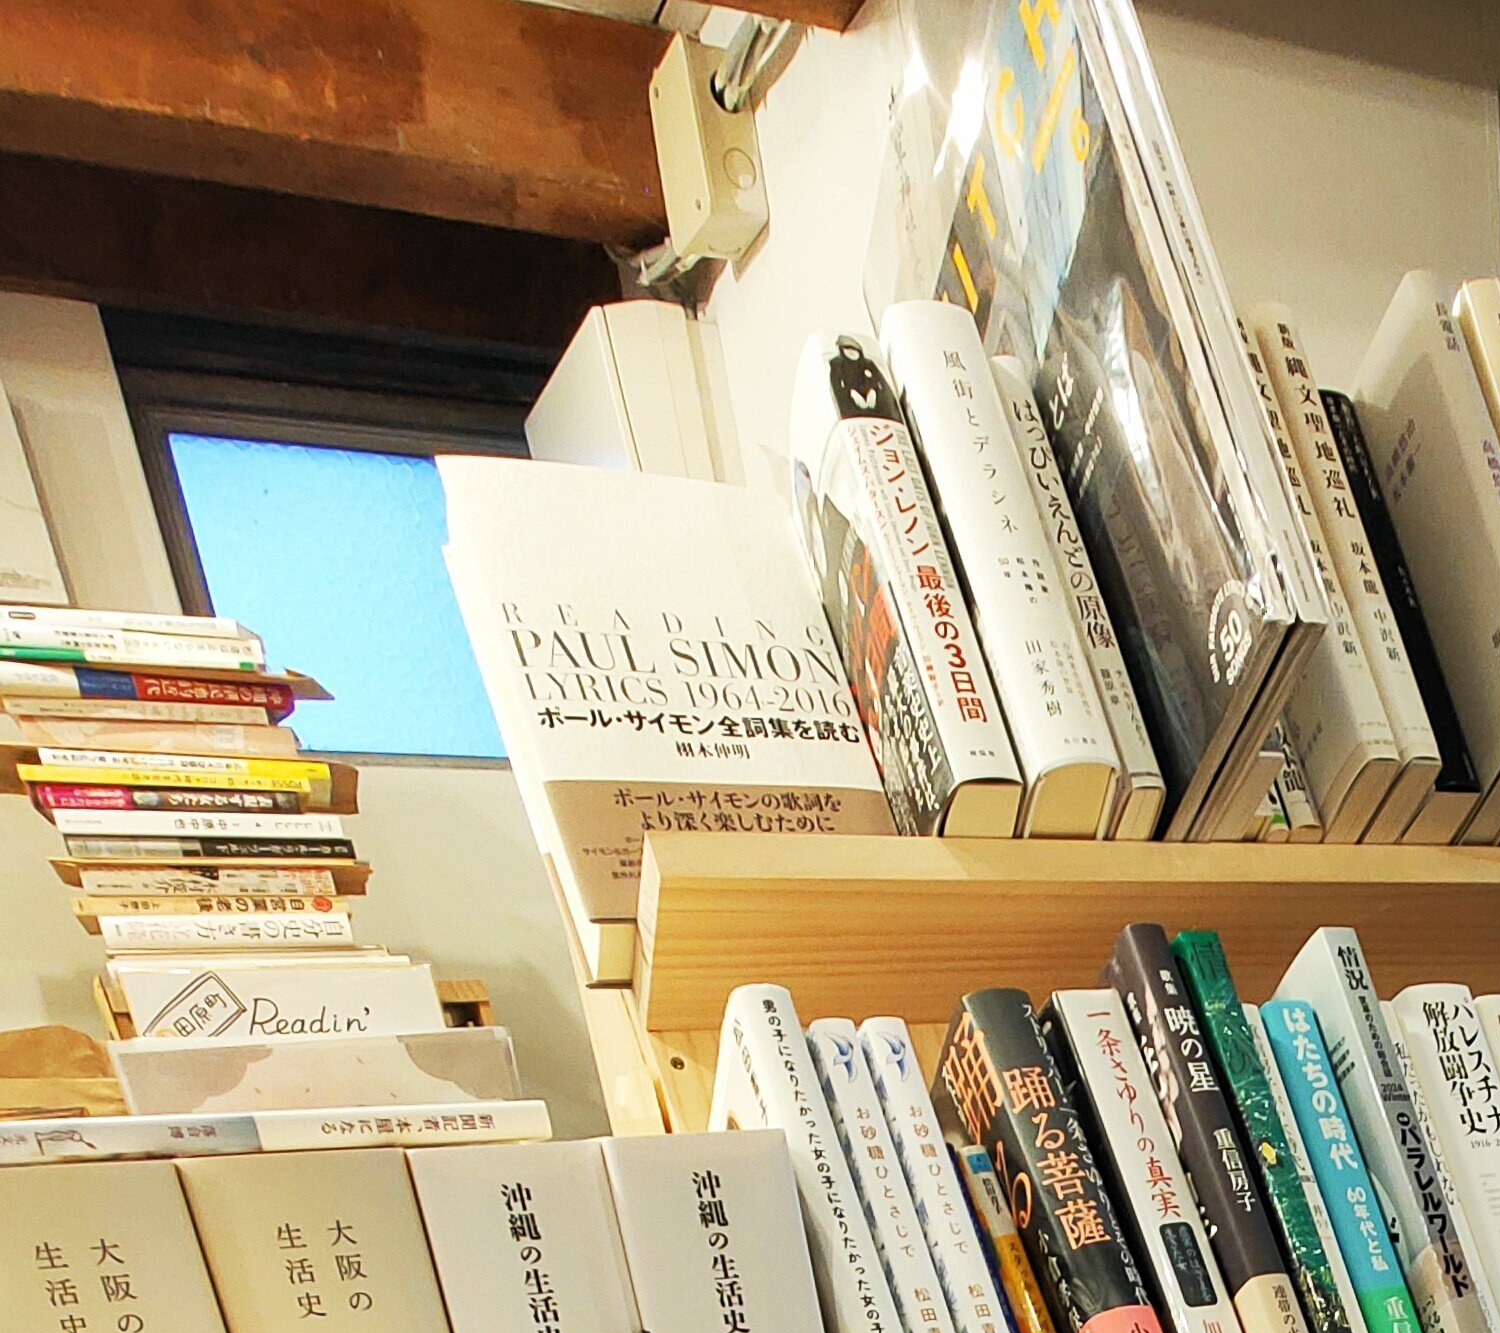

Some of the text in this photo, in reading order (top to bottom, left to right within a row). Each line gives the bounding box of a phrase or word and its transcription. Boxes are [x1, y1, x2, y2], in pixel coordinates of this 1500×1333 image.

[1285, 357, 1355, 519] 縄文聖地巡礼
[870, 423, 930, 557] ジョン・レノン
[916, 565, 988, 723] 最後の3日間
[509, 629, 842, 686] PAUL SIMON
[526, 672, 852, 718] LYRICS 1964-2016
[1337, 946, 1369, 990] 情況
[1164, 1006, 1219, 1094] 暁の星
[1282, 1007, 1359, 1170] はたちの時代
[1422, 1001, 1488, 1135] 解放闘争史
[1000, 1066, 1111, 1250] 踊る菩薩
[1086, 1007, 1182, 1219] 一条さゆりの真実
[1211, 1127, 1256, 1213] 重信房子
[855, 1108, 916, 1259] お砂糖ひとさじで
[909, 1105, 968, 1255] お砂糖ひとさじで
[1346, 1187, 1389, 1271] 60年代と私
[275, 1224, 328, 1320] 生活史
[326, 1220, 375, 1313] 大阪の
